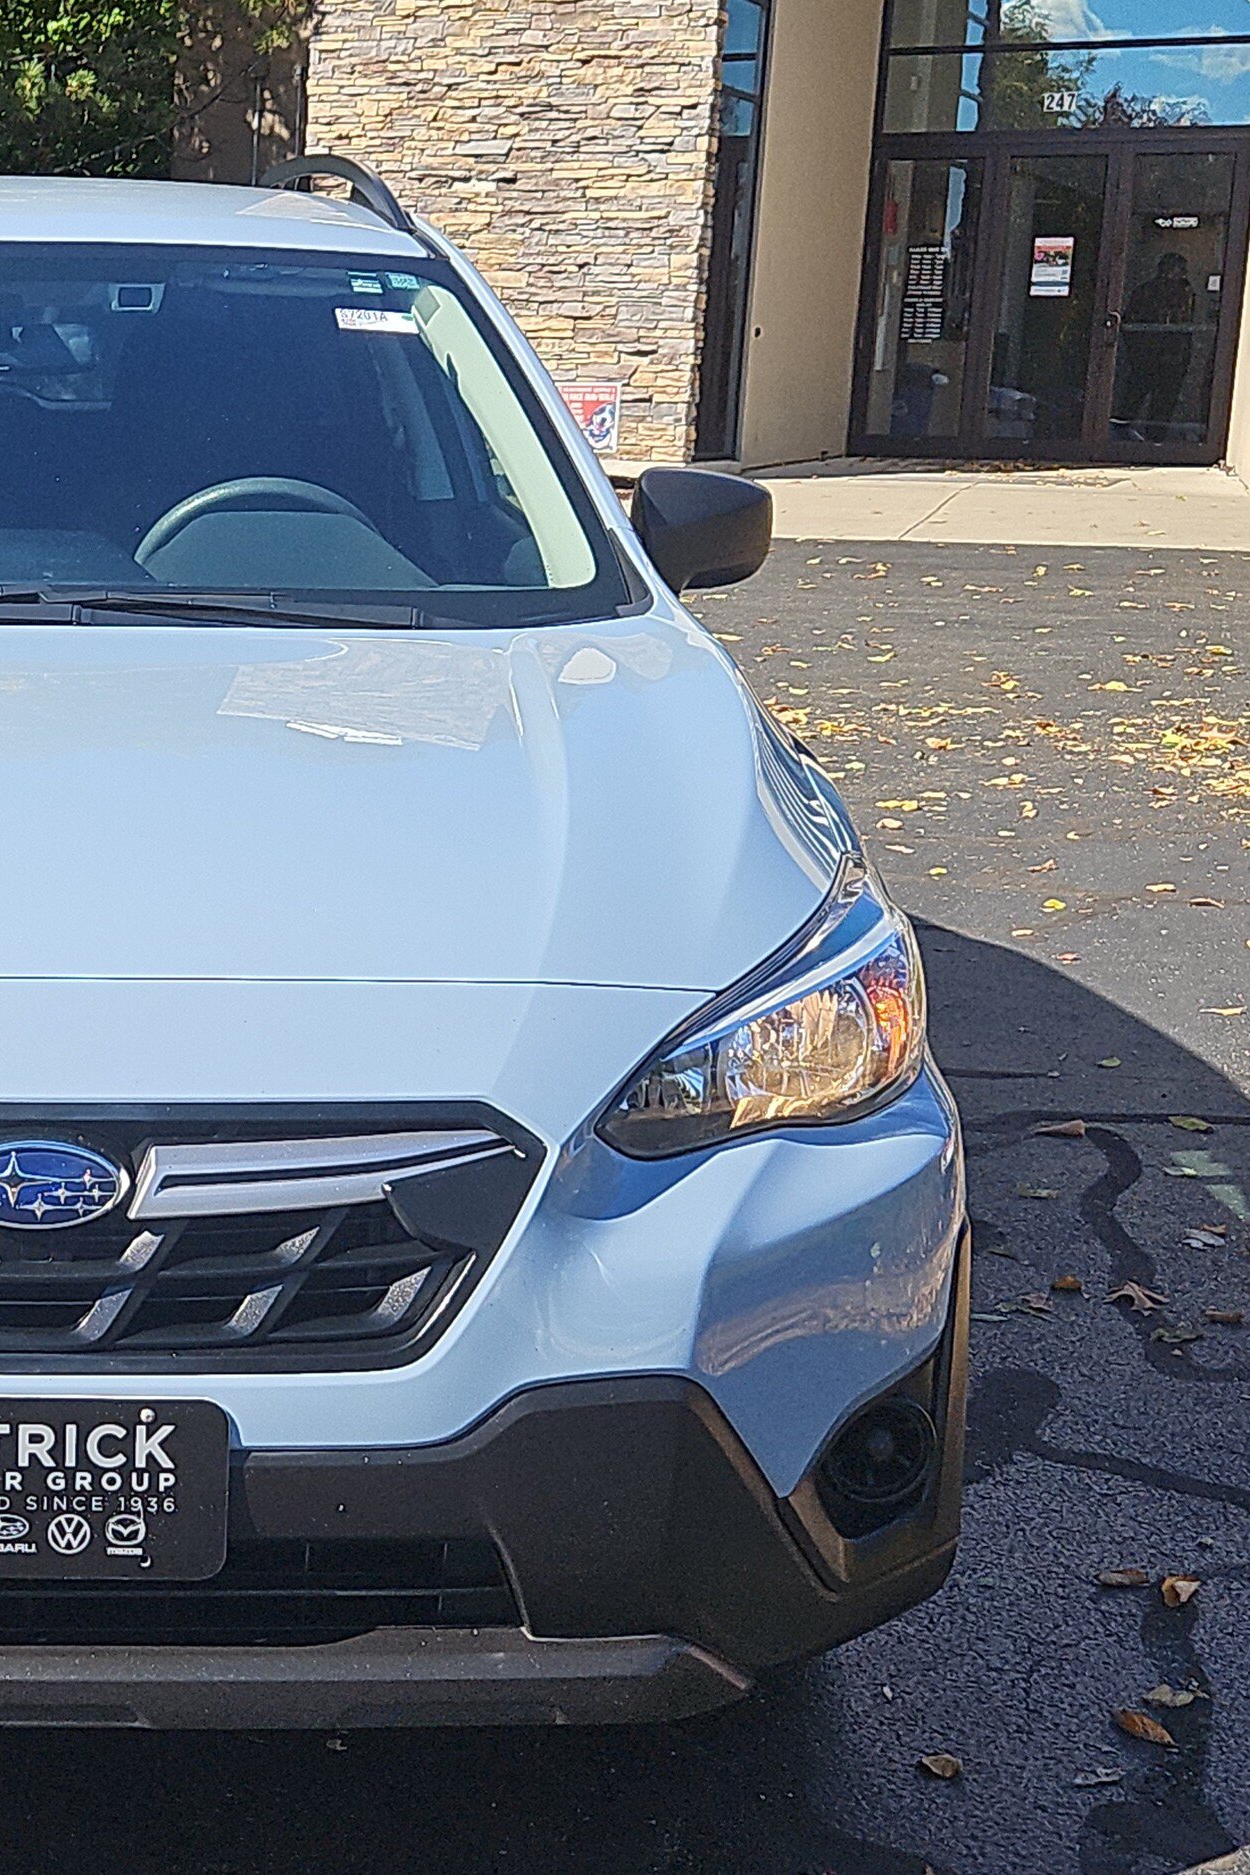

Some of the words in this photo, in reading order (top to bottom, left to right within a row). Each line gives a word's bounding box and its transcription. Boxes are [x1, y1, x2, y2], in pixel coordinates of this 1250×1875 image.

[1046, 92, 1076, 111] 247
[46, 1471, 177, 1493] GROUP
[25, 1496, 105, 1512] SINCE
[117, 1496, 176, 1513] 1936
